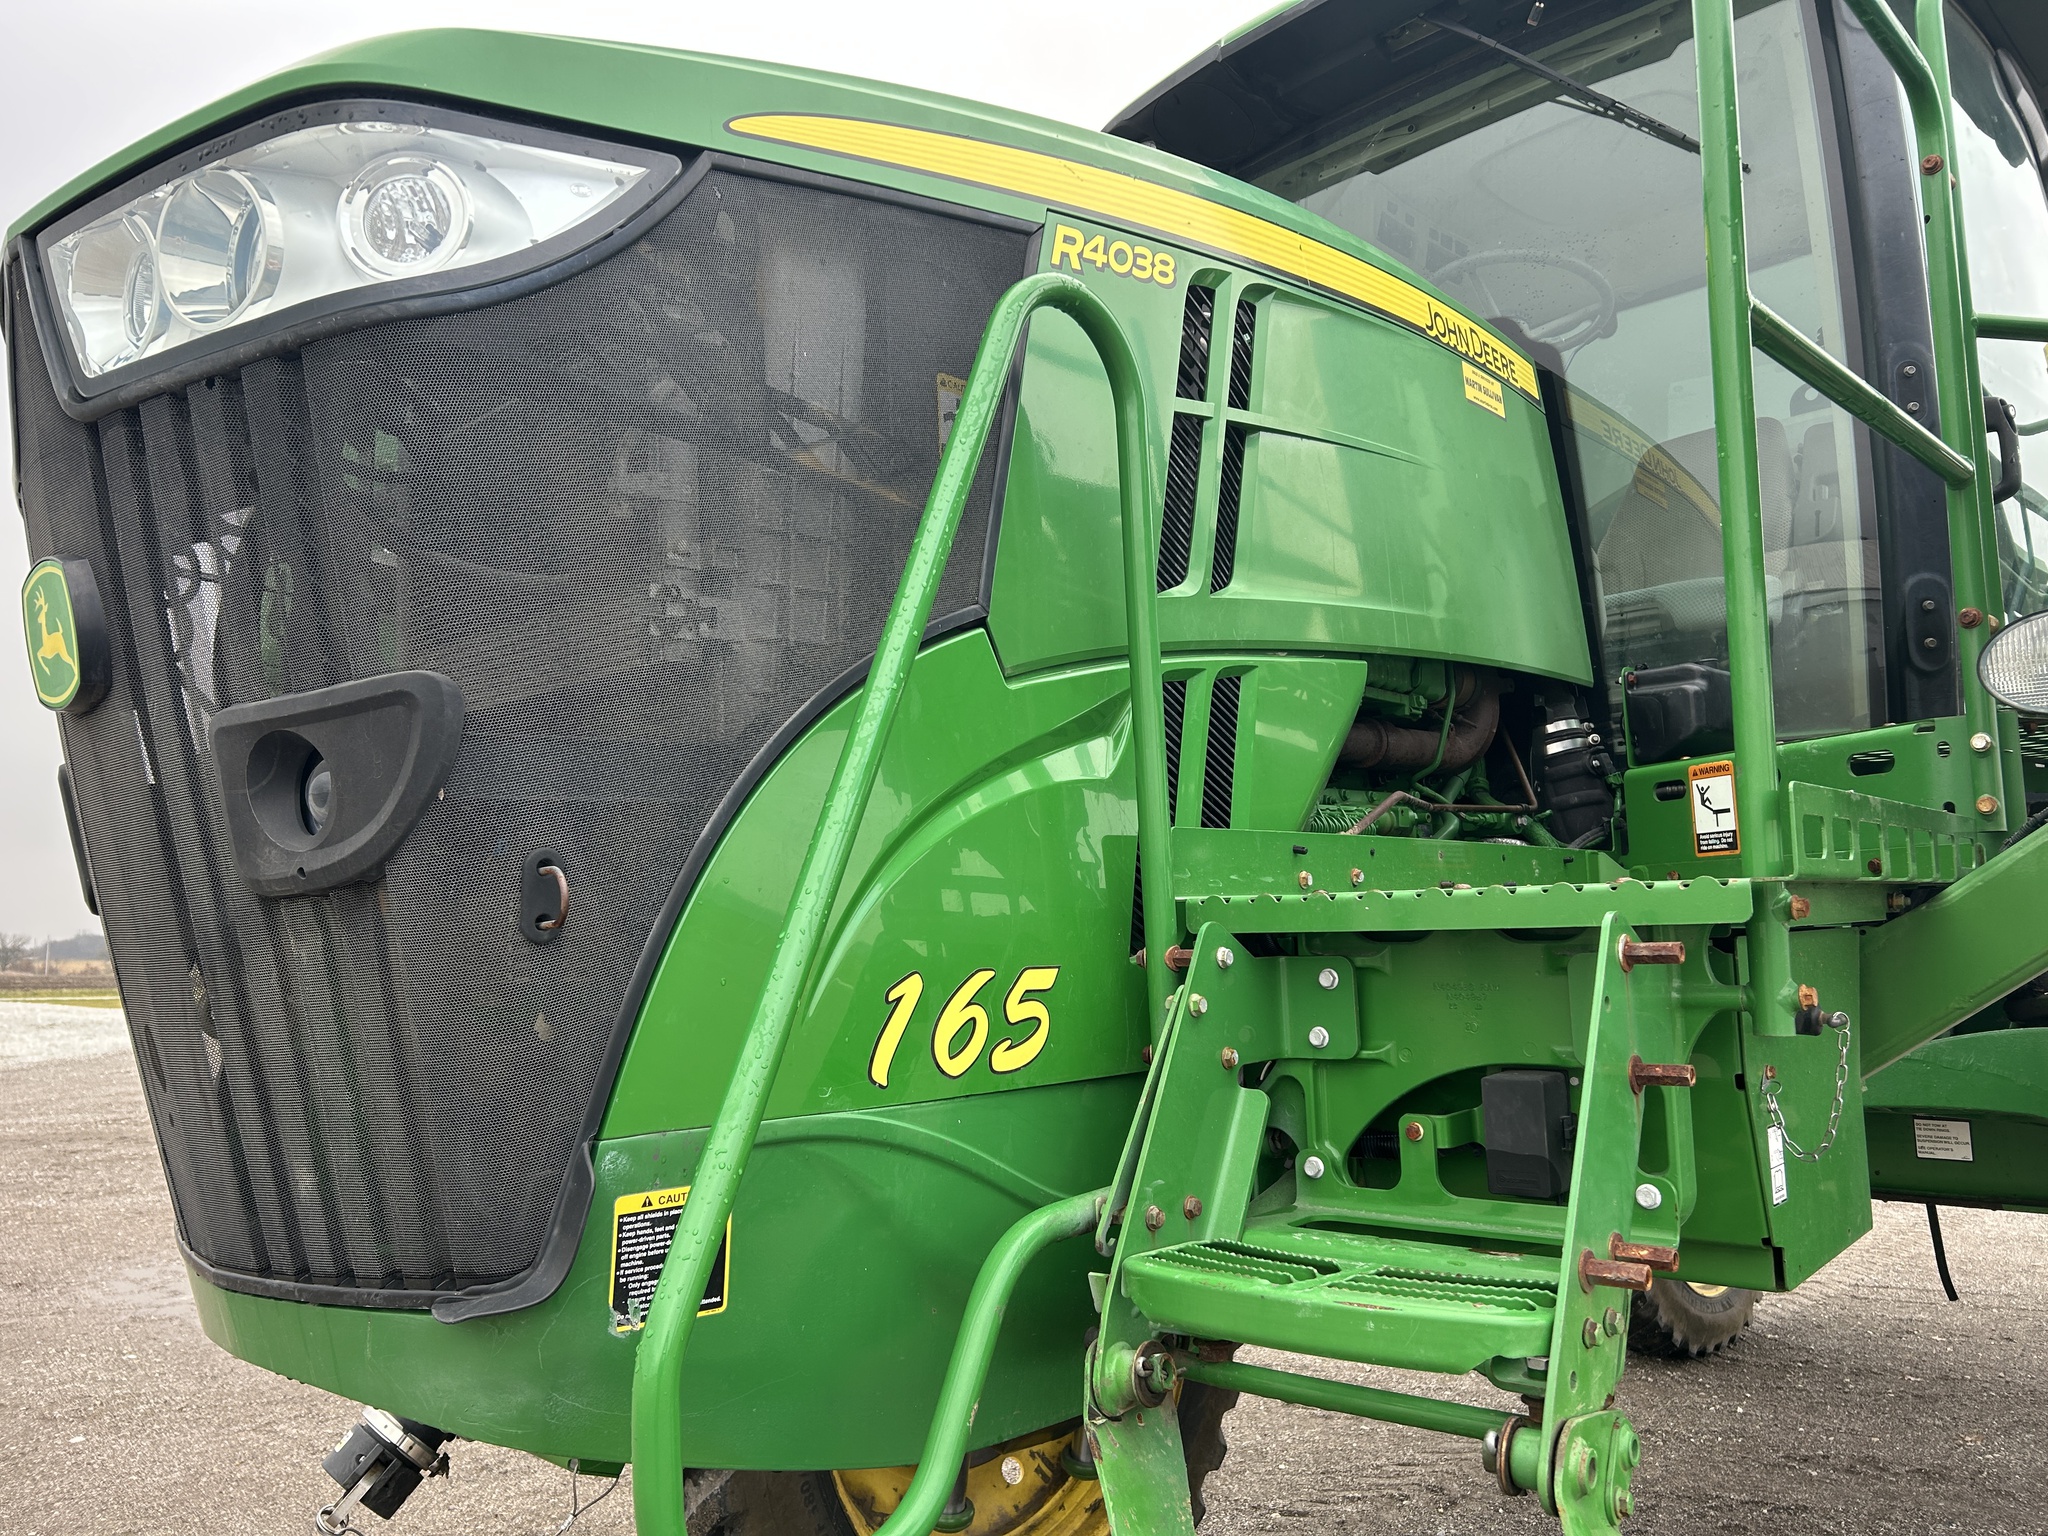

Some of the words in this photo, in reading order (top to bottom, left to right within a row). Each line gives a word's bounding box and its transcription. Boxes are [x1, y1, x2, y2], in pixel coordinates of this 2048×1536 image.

[1051, 223, 1176, 286] R4038
[1425, 302, 1470, 353] JOHN
[1469, 326, 1519, 384] DEERE
[1465, 376, 1482, 393] MARTIN
[1482, 386, 1502, 404] SULLIVAN
[1699, 764, 1729, 775] WARNING
[868, 966, 1061, 1089] 165
[658, 1192, 687, 1205] CAUT
[622, 1235, 655, 1246] power-driven
[622, 1242, 648, 1253] Disengage
[620, 1260, 644, 1268] machine.
[644, 1263, 663, 1272] proced
[629, 1288, 650, 1296] required
